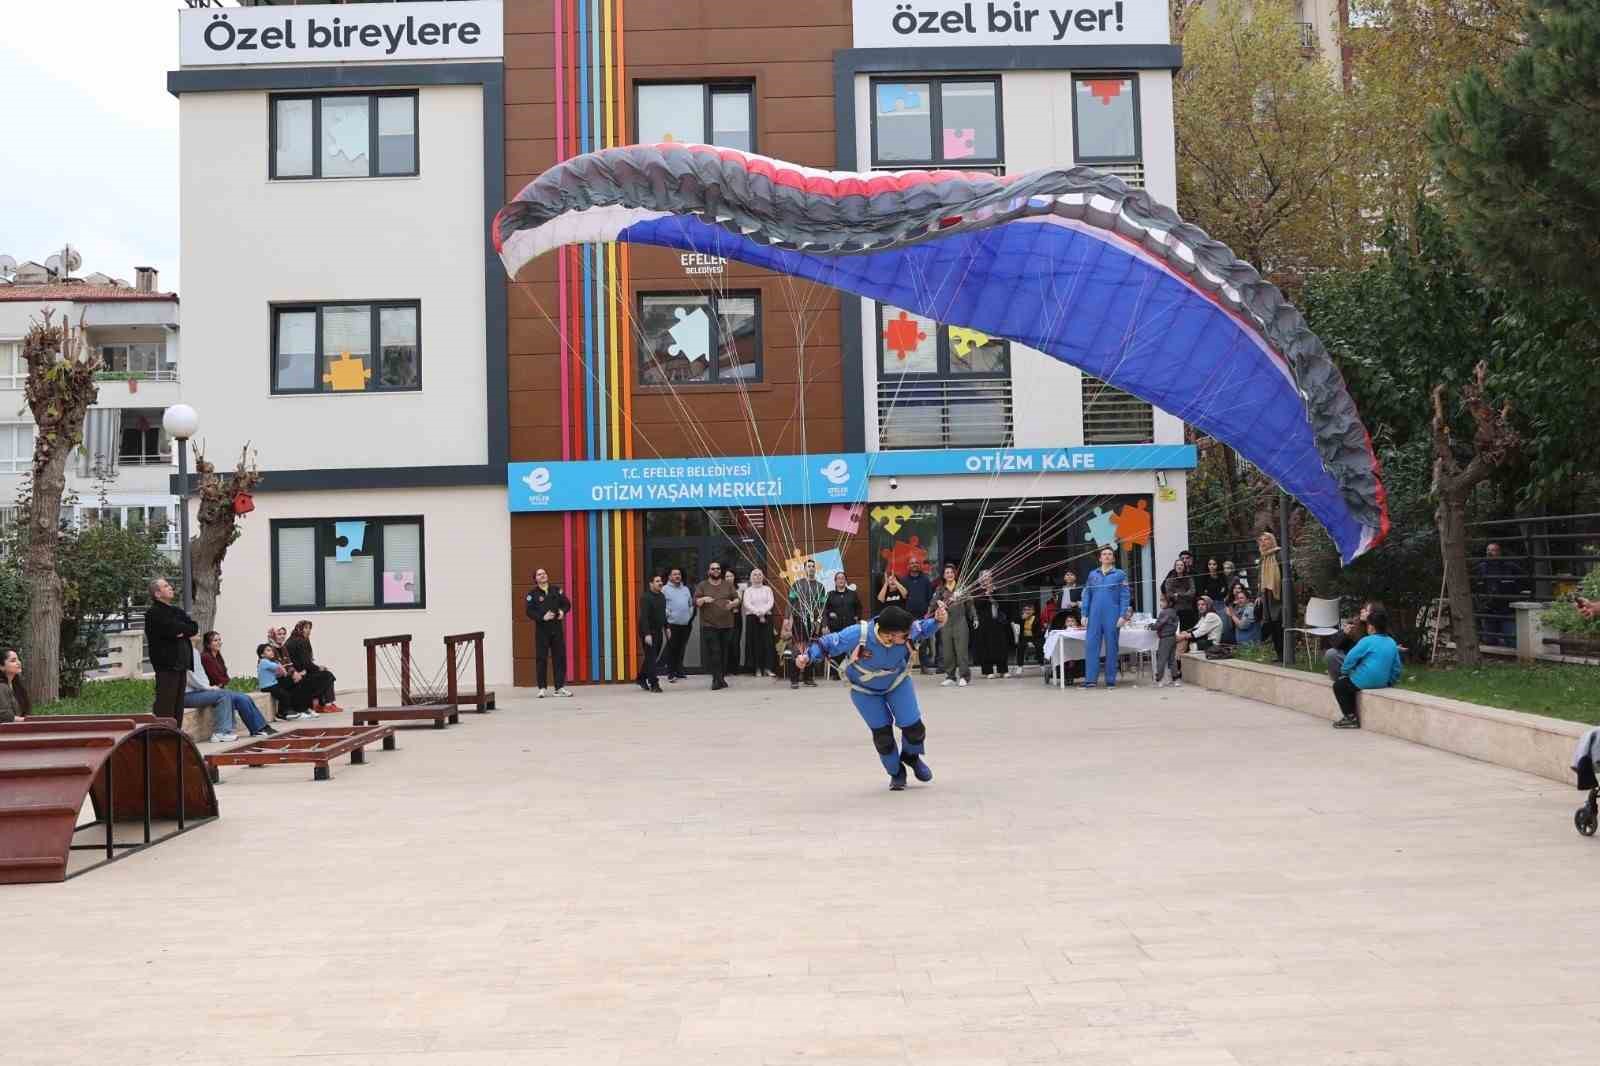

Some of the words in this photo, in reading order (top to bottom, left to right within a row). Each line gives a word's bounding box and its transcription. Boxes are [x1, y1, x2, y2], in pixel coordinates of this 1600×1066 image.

[892, 3, 976, 35] özel
[987, 2, 1039, 33] bir
[1048, 1, 1124, 40] yer!
[204, 14, 296, 51] Özel
[307, 16, 481, 54] bireylere
[681, 254, 727, 266] EFELER
[622, 468, 641, 480] T.C.
[643, 466, 684, 479] EFELER
[687, 463, 751, 477] BELEDİYESİ
[966, 452, 1033, 471] OTİZM
[1042, 453, 1095, 469] KAFE
[592, 482, 643, 501] OTİZM
[647, 483, 703, 502] YAŞAM
[708, 478, 783, 498] MERKEZİ
